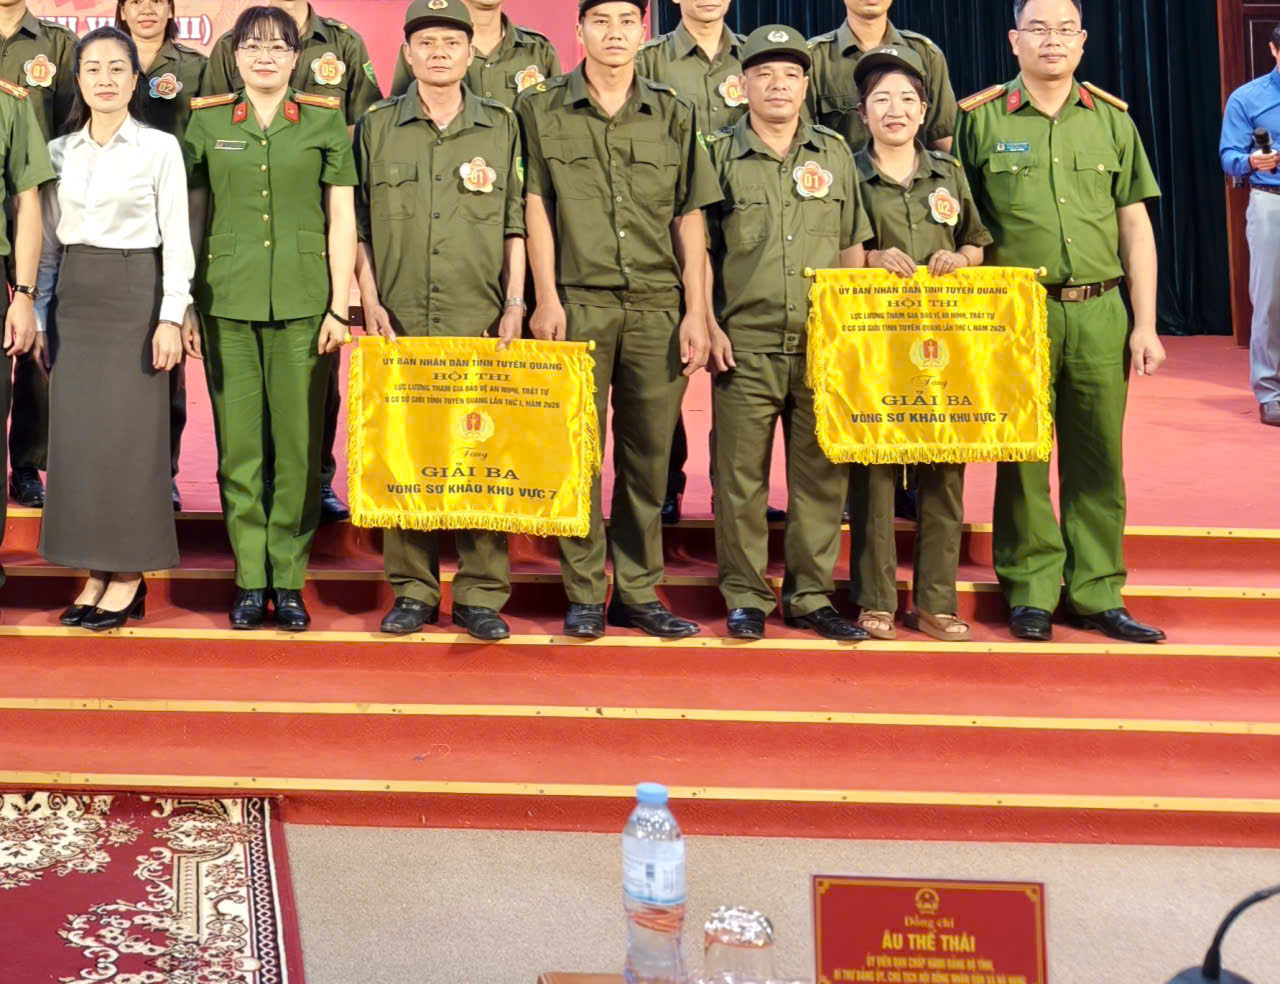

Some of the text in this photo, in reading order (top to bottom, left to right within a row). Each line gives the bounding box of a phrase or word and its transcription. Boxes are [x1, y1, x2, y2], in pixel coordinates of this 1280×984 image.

[321, 63, 336, 77] 05
[160, 82, 173, 94] 02
[937, 200, 951, 214] 02
[433, 371, 468, 382] HỘI
[881, 390, 973, 406] GIẢI BA
[887, 412, 905, 422] SƠ
[910, 409, 945, 422] KHẢO
[950, 413, 970, 422] KHU
[973, 412, 996, 424] VỰC
[1000, 413, 1008, 422] 7
[421, 462, 520, 481] GIẢI BA
[426, 483, 445, 495] SƠ
[448, 480, 483, 494] KHẢO
[487, 484, 514, 496] KHU
[518, 487, 546, 500] VỰC
[549, 490, 557, 500] 7
[881, 928, 903, 950] ÂU
